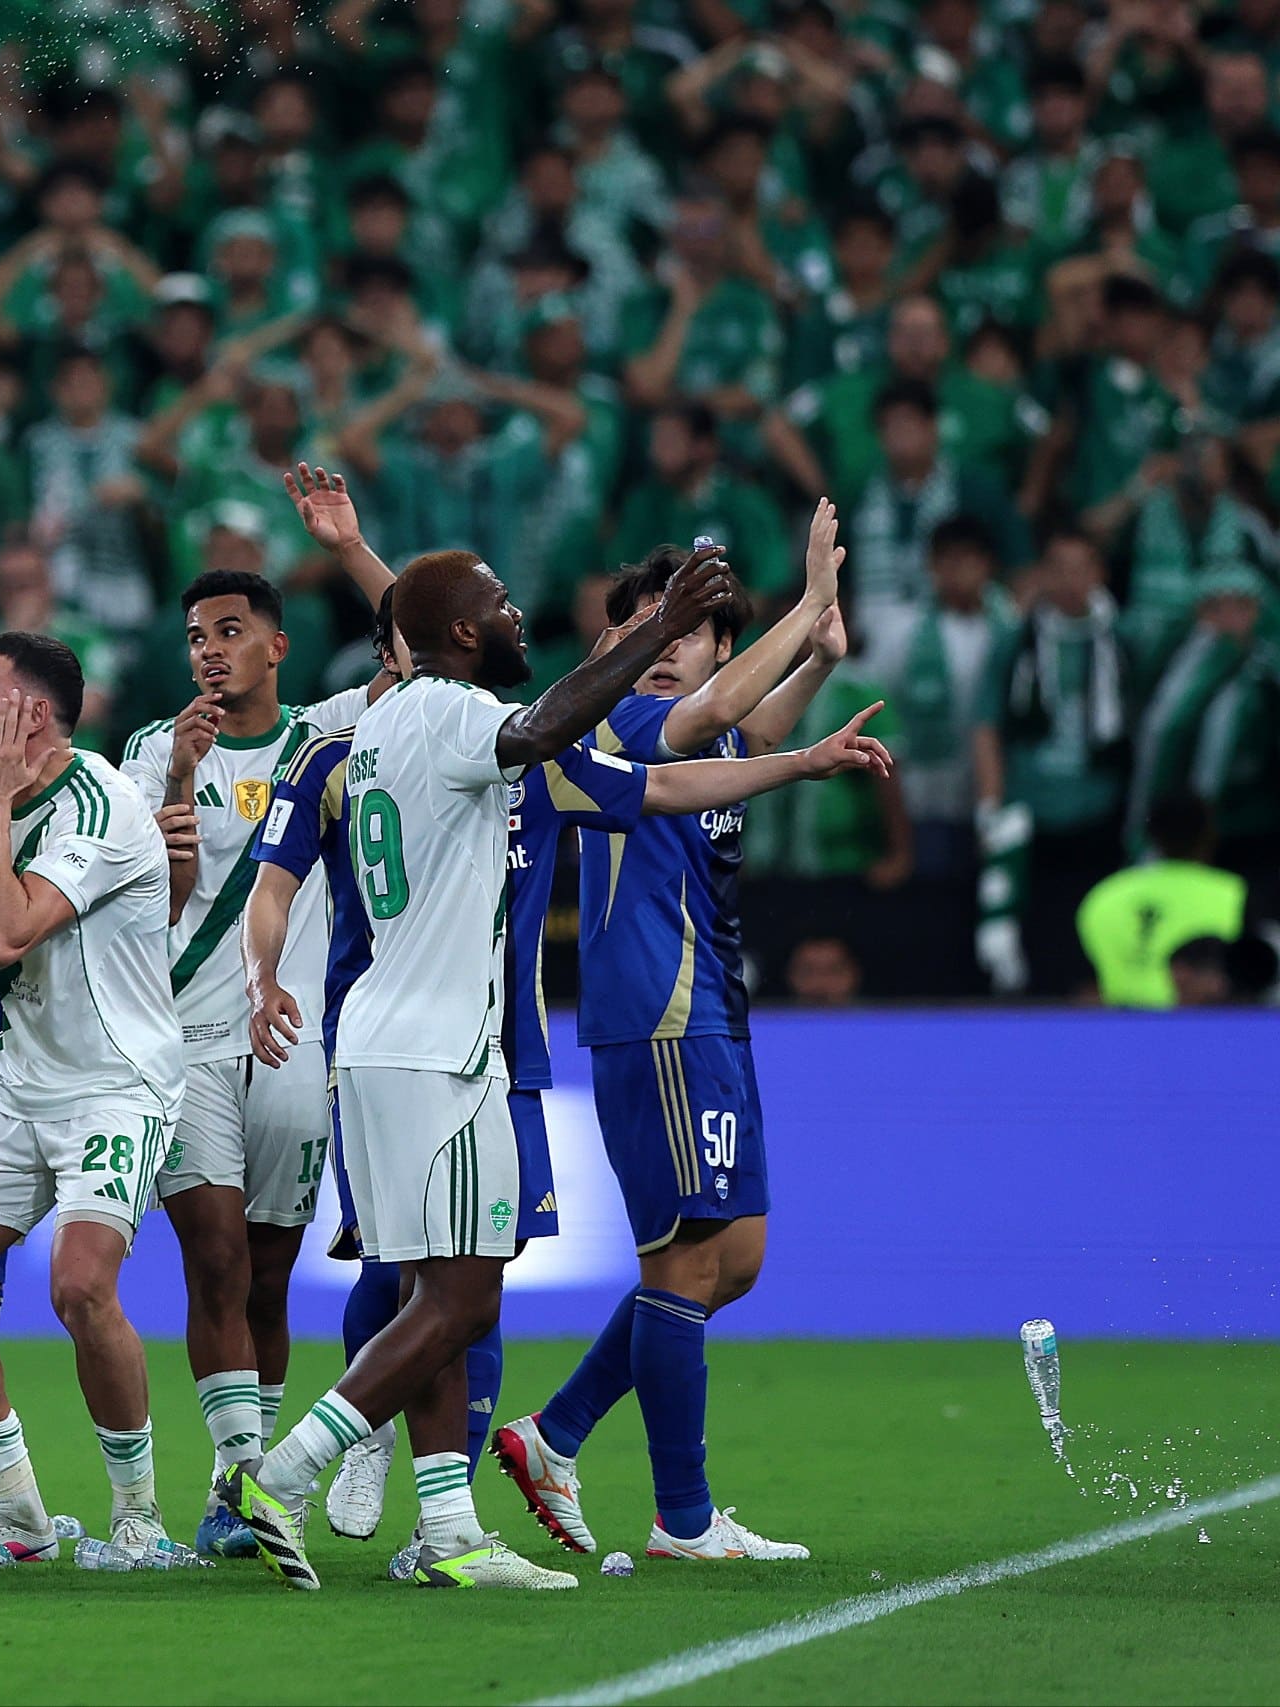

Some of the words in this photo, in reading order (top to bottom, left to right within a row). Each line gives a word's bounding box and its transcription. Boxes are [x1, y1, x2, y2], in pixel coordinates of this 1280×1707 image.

[62, 851, 89, 869] AFC
[81, 1134, 135, 1175] 28
[701, 1109, 737, 1169] 50
